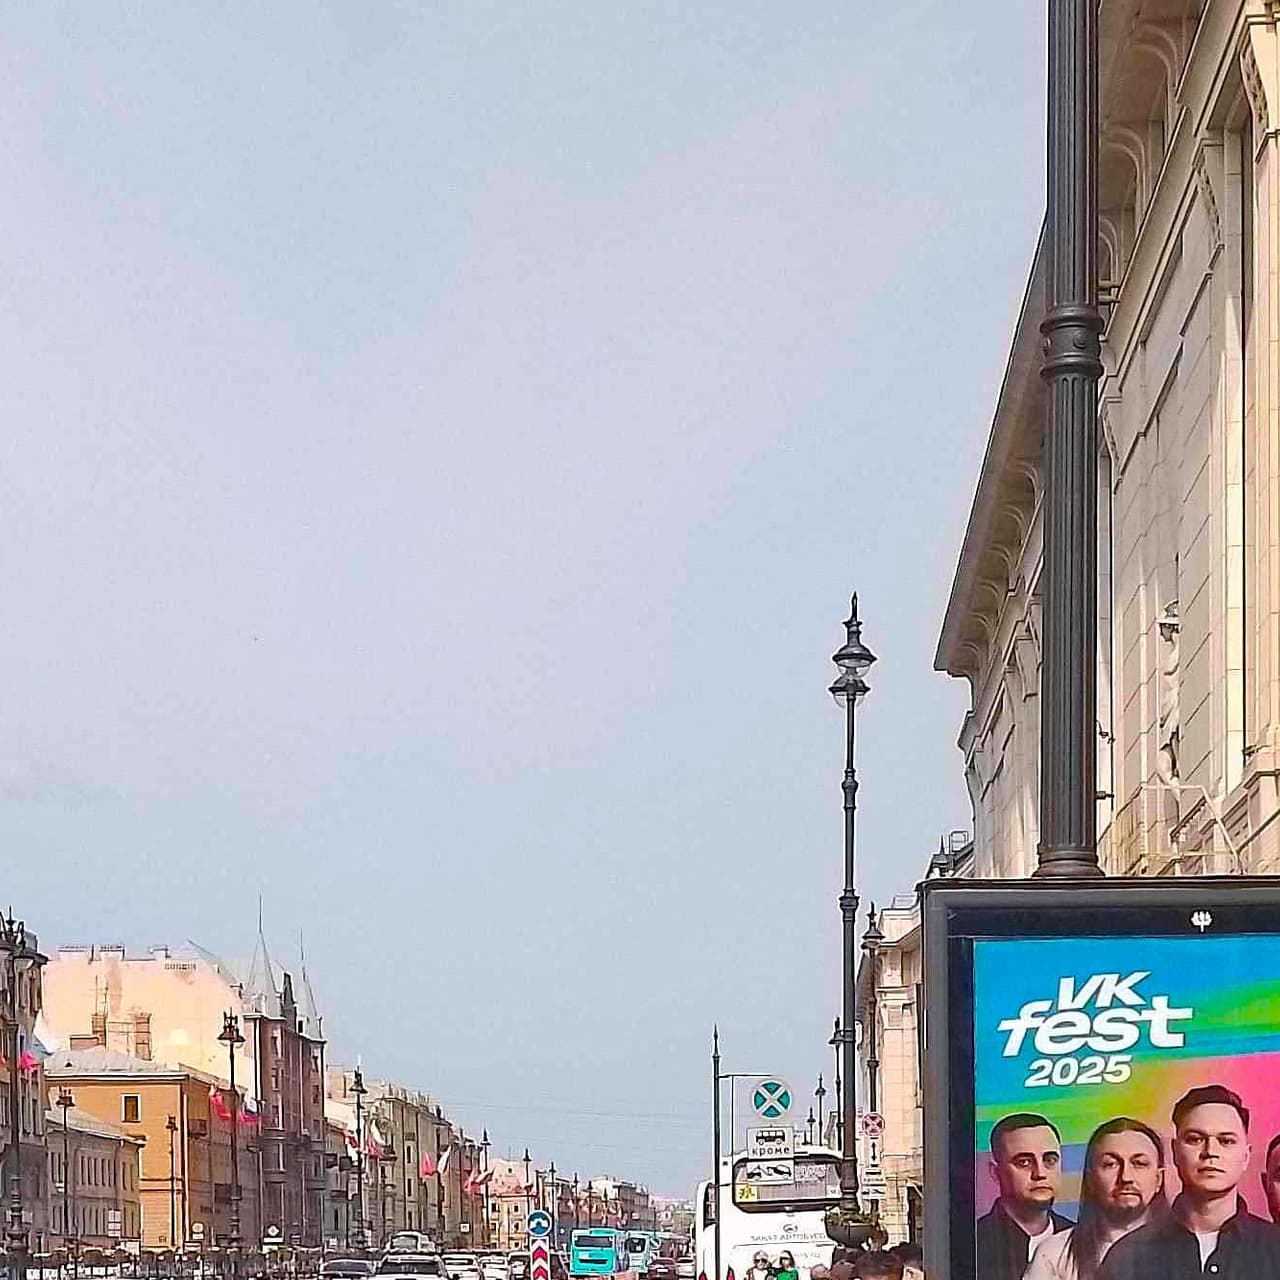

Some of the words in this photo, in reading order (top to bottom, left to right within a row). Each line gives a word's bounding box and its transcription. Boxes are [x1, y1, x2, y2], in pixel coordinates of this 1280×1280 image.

[1056, 970, 1152, 1010] VK
[997, 995, 1194, 1057] fest
[1024, 1054, 1133, 1088] 2025
[752, 1146, 790, 1156] кроме
